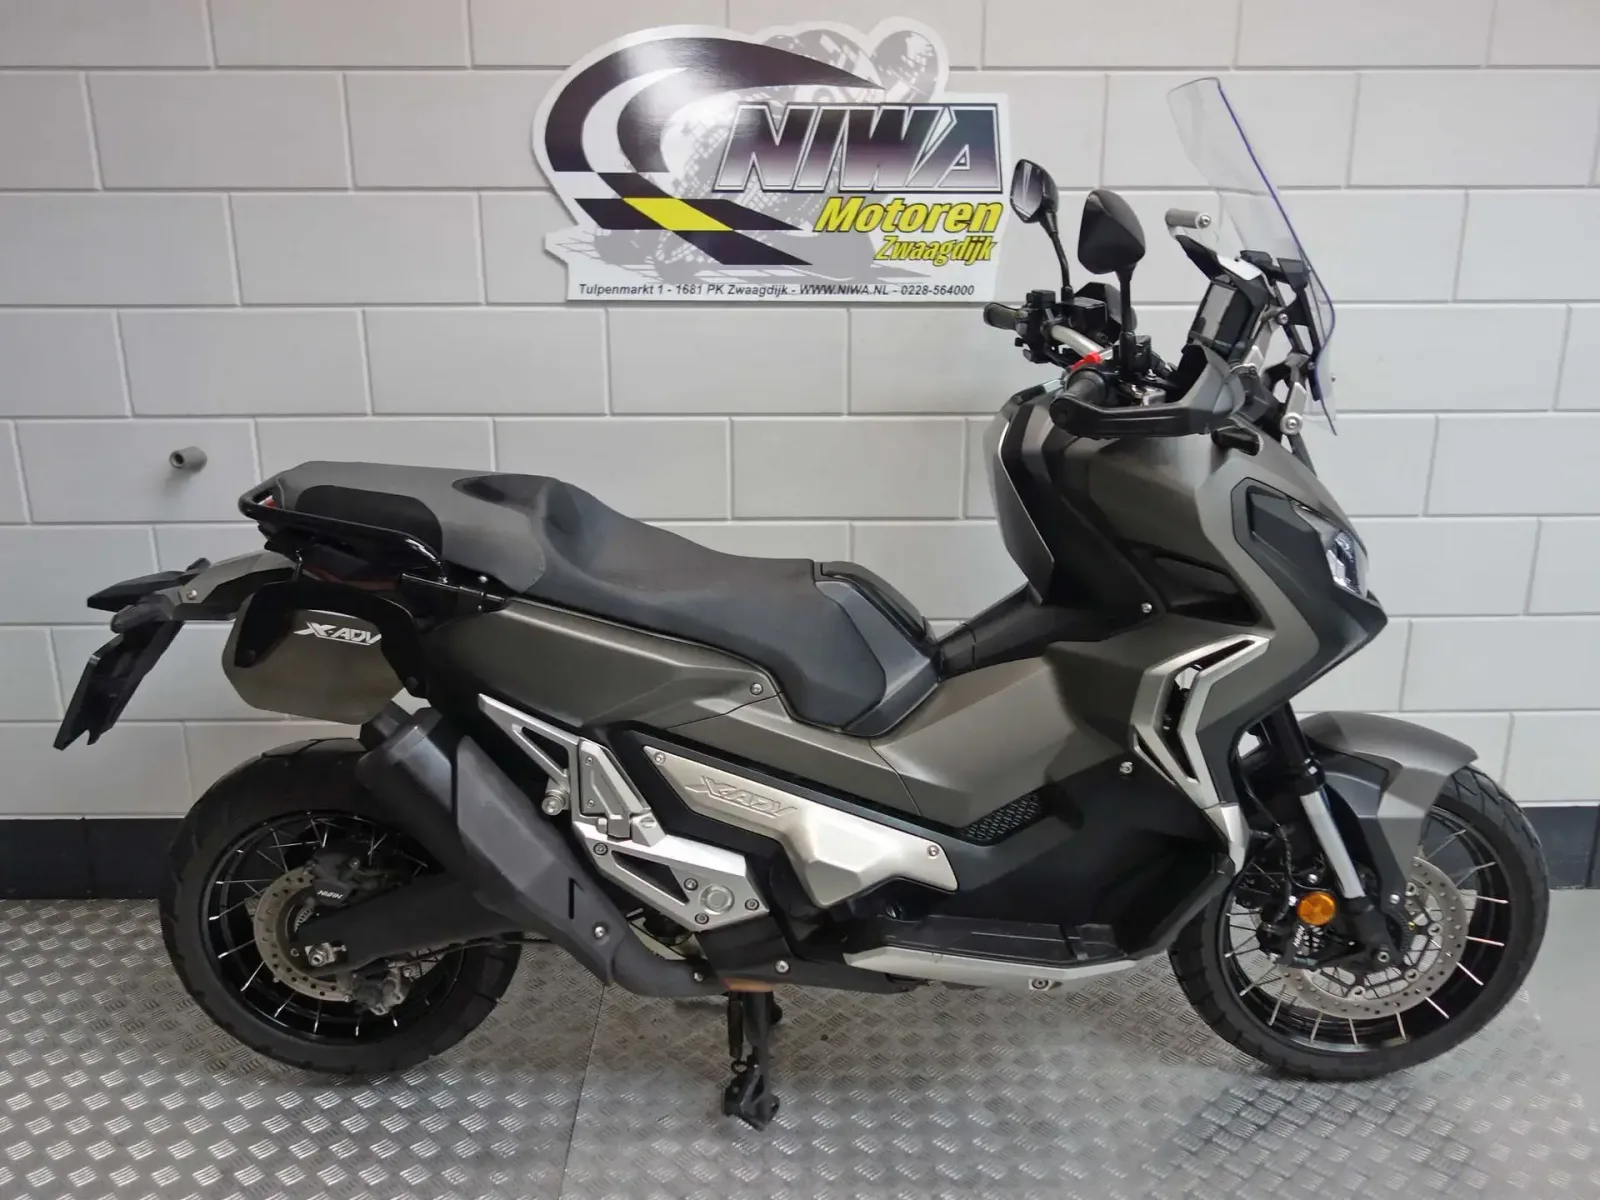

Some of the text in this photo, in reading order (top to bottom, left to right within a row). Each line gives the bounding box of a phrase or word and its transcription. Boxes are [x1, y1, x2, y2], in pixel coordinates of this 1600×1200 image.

[712, 102, 1003, 194] NIWA
[812, 196, 1004, 233] Motoren
[873, 235, 997, 266] Zwaagdijk
[579, 284, 655, 298] Tulpenmarkt
[657, 285, 664, 295] 1
[676, 284, 703, 296] 1681
[706, 284, 725, 296] PK
[727, 285, 789, 299] Zwaagdijk
[799, 285, 890, 296] WWW.NIWA.NL
[901, 285, 976, 296] 0228-564000
[293, 620, 382, 646] X-ADV
